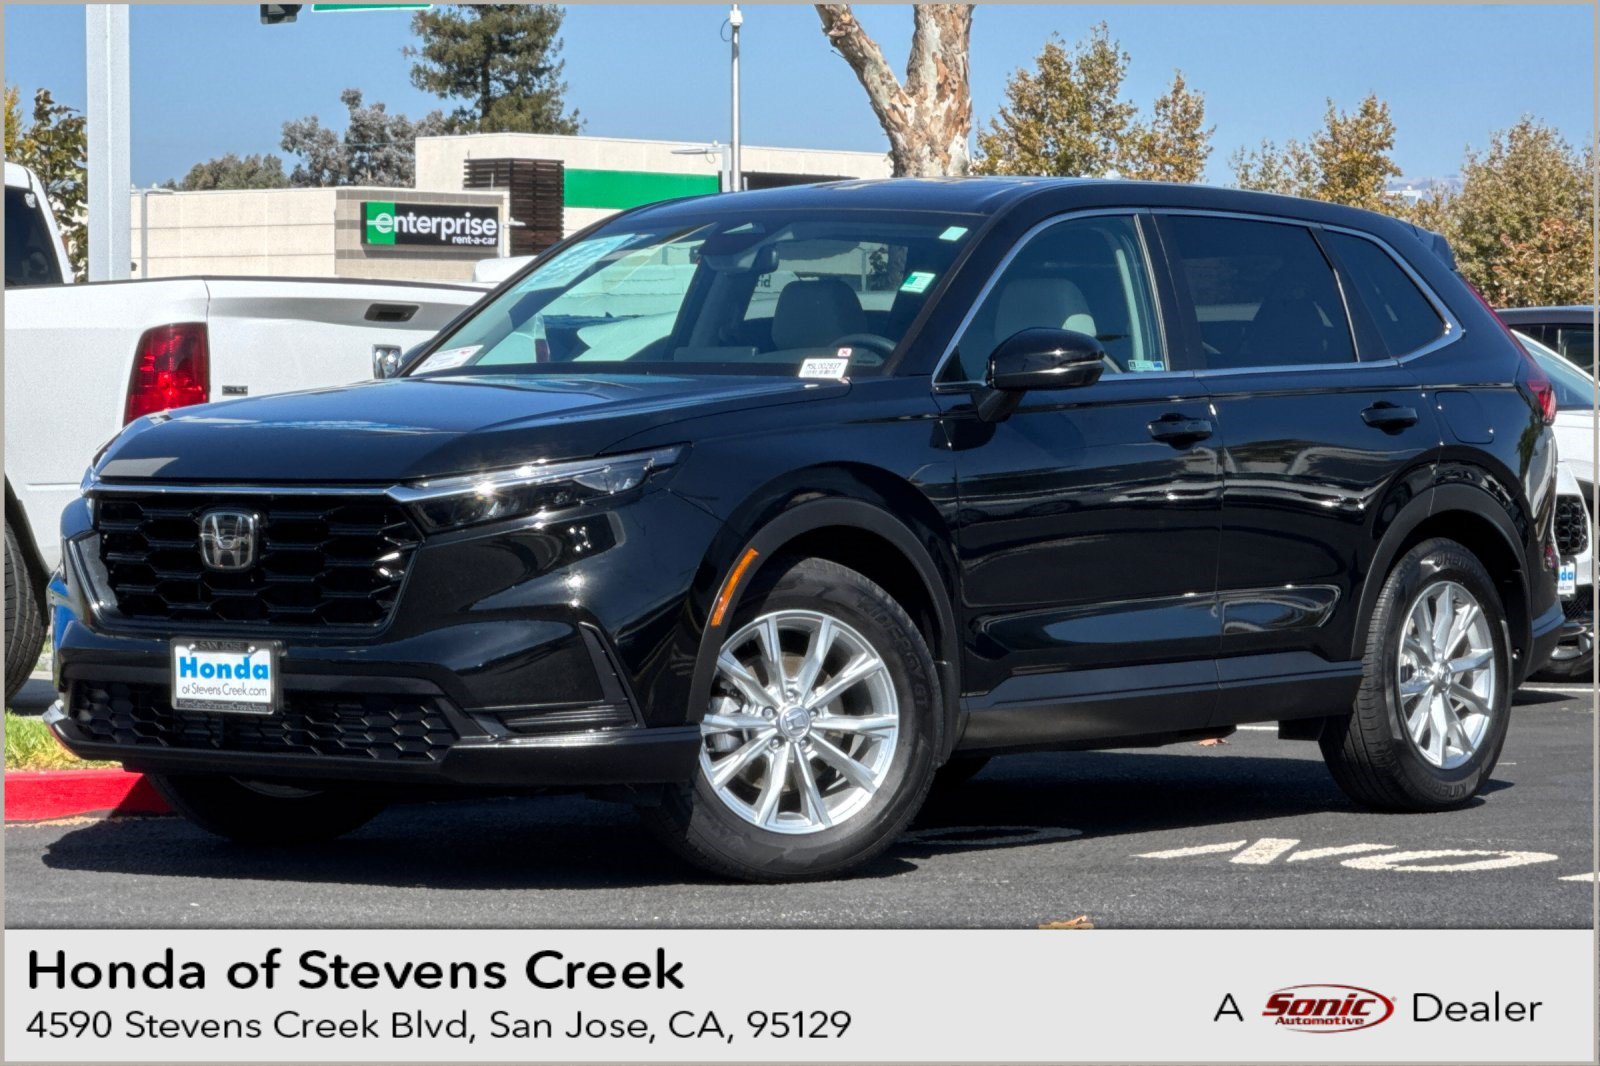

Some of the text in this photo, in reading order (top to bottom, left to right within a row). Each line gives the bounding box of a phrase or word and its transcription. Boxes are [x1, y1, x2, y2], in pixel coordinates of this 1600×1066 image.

[367, 211, 497, 241] enterprise
[452, 235, 496, 245] rent-a-car
[179, 656, 269, 680] Honda
[182, 682, 267, 697] of Stevens Creek.com
